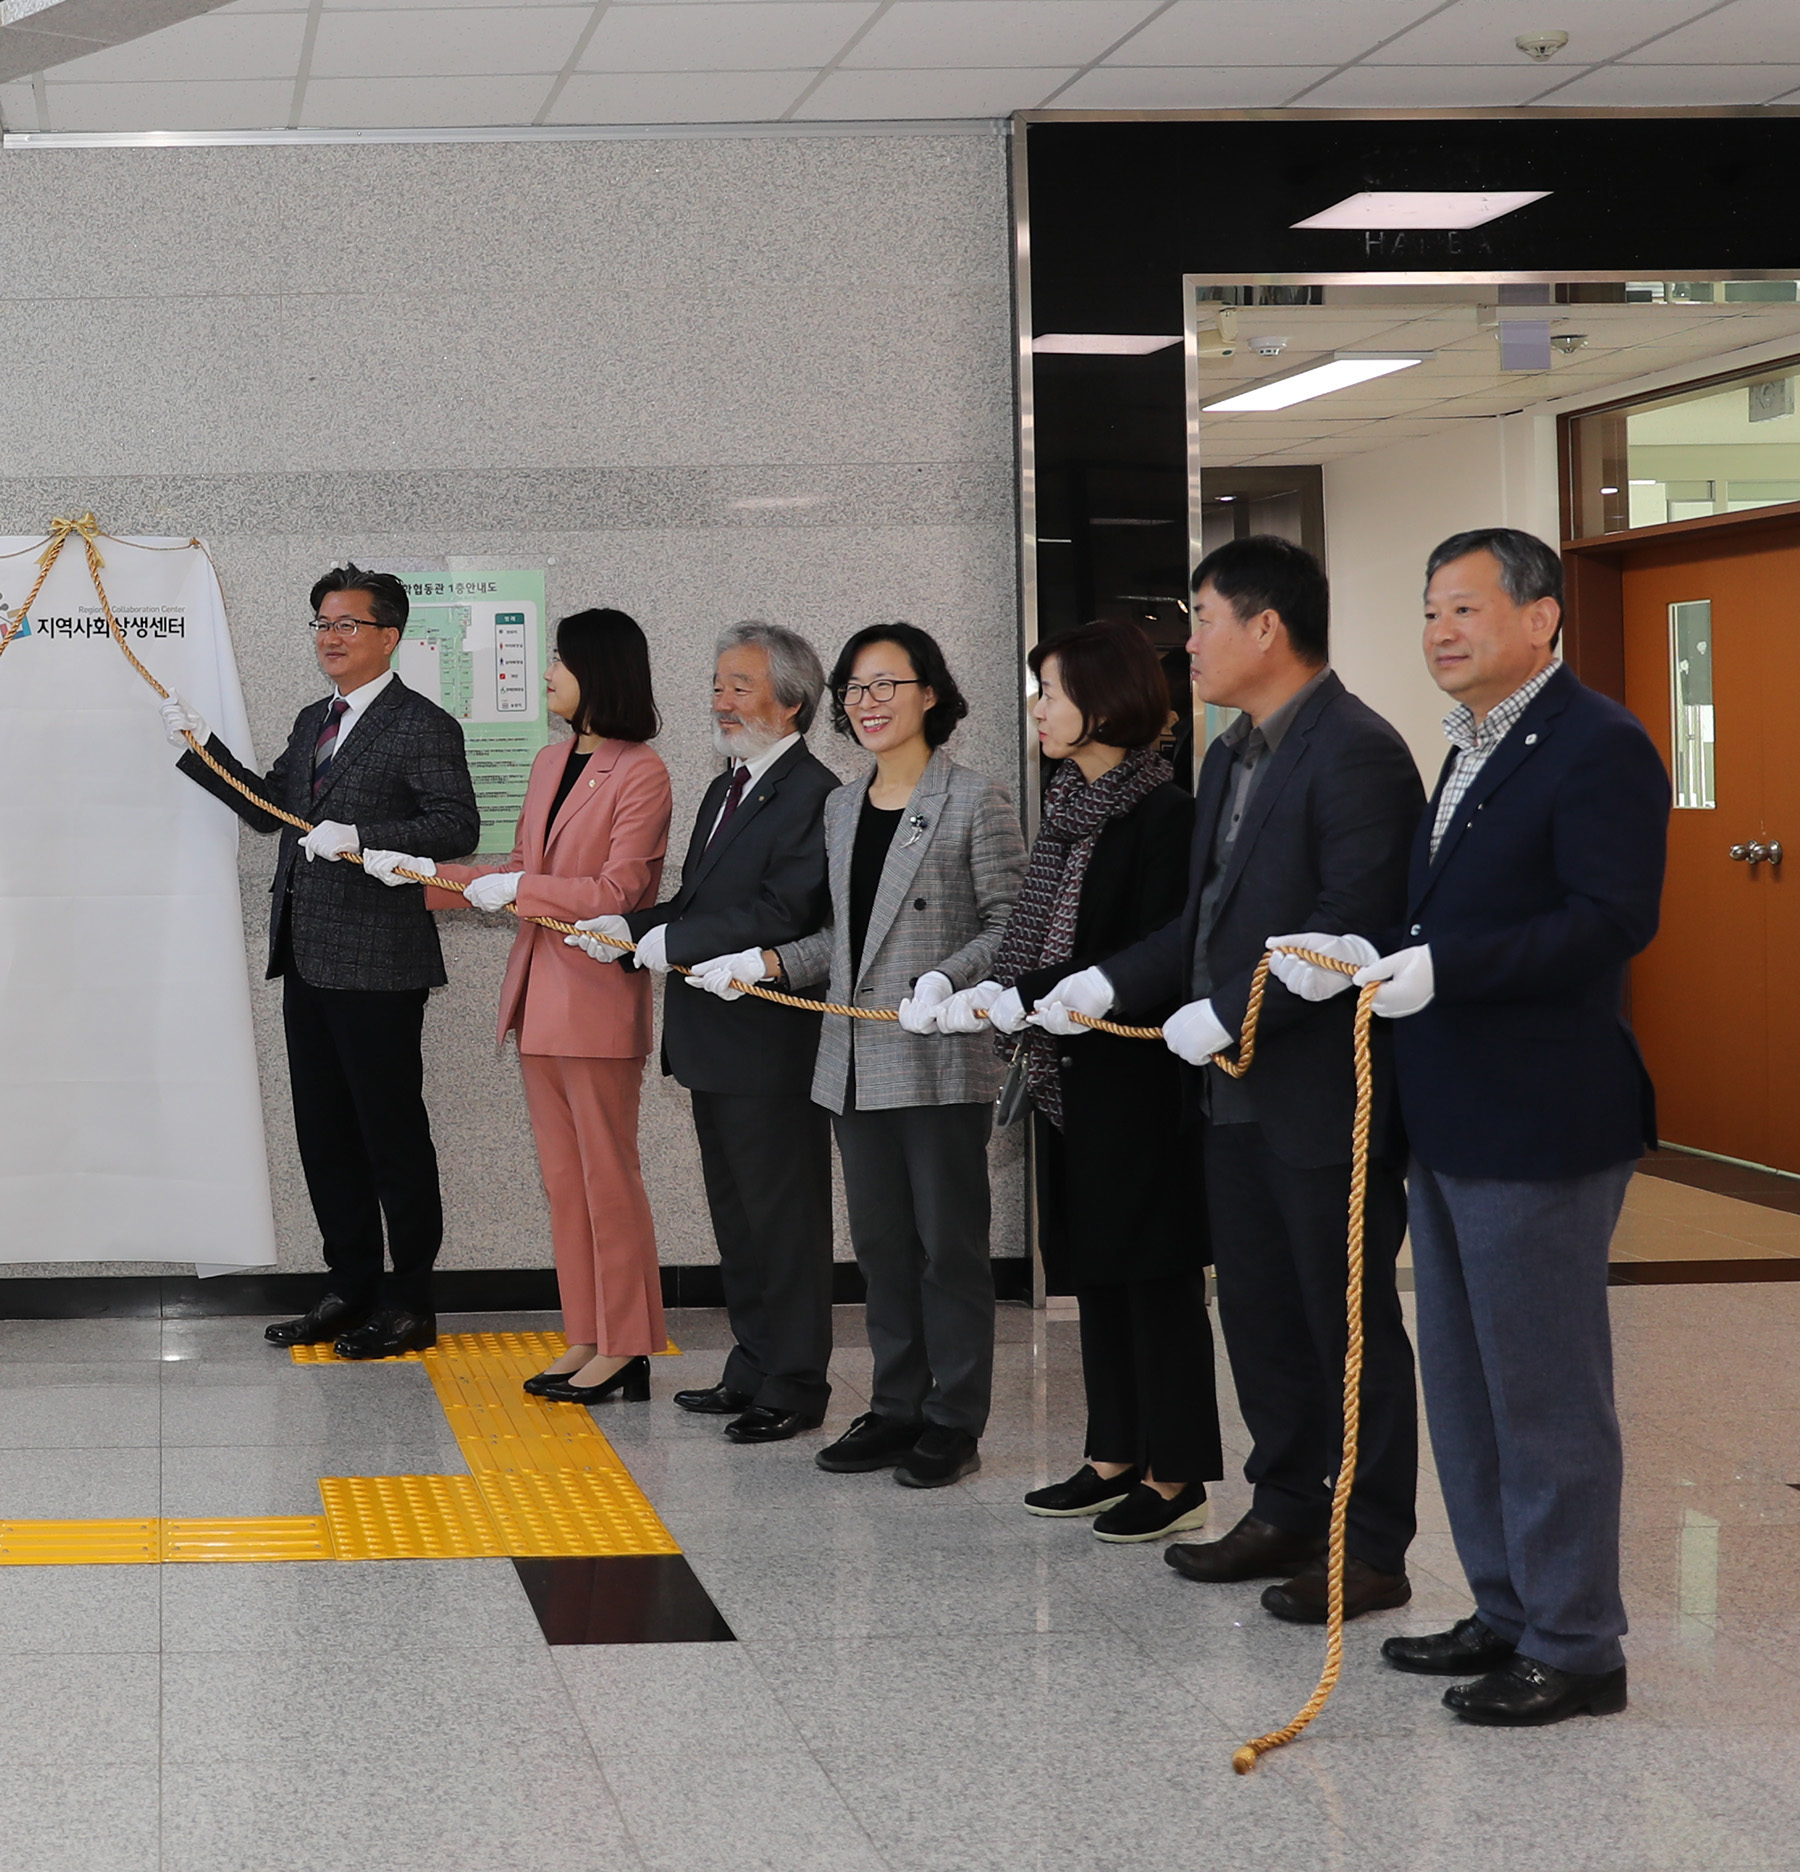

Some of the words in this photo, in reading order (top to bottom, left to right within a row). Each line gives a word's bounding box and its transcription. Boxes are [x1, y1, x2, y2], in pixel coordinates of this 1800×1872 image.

[449, 582, 497, 595] 1층안내도
[78, 606, 105, 614] Region
[111, 605, 160, 613] Collaboration
[161, 605, 186, 613] Center
[37, 616, 186, 639] 지역사회상생센터
